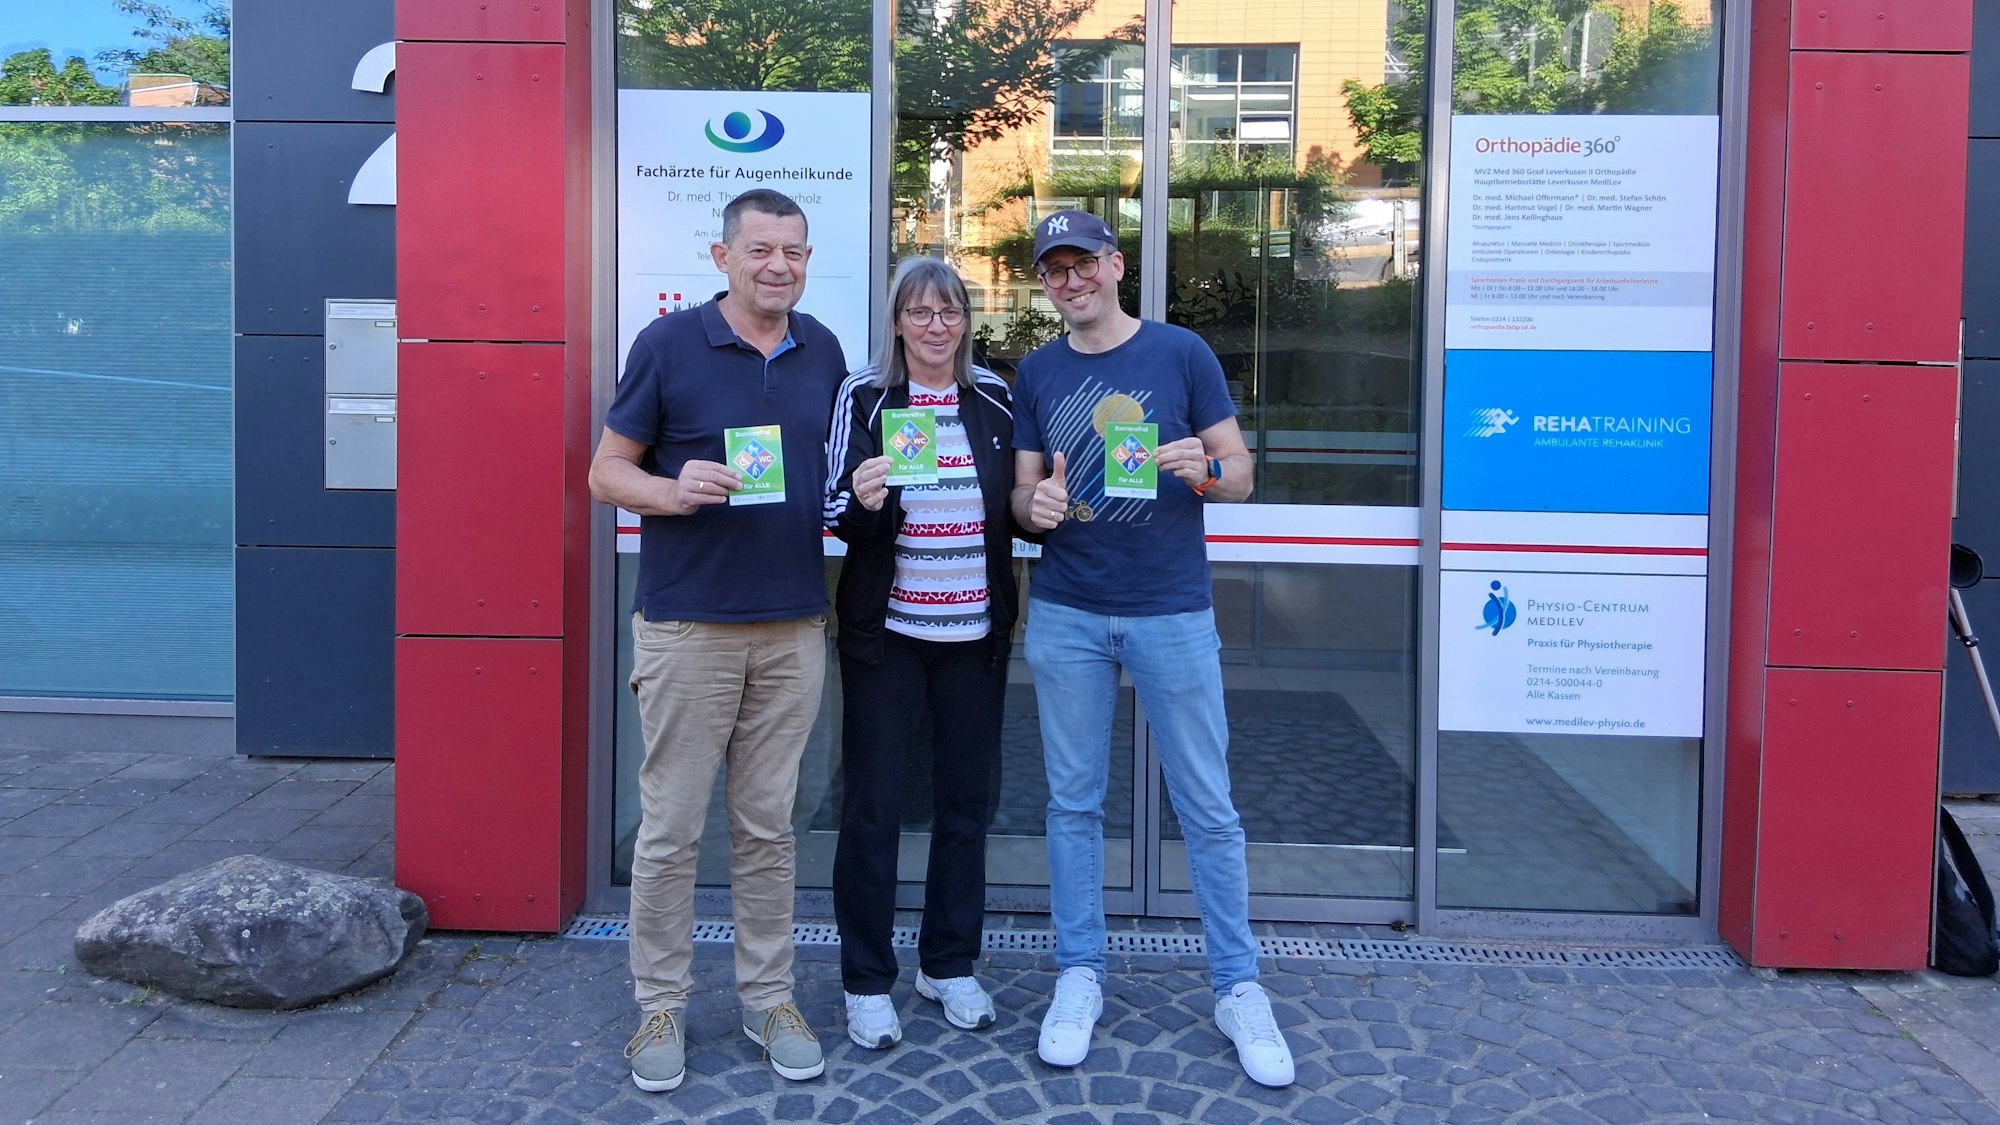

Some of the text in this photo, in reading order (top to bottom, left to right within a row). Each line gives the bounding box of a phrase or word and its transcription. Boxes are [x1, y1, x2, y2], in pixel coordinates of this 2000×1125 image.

[1475, 136, 1581, 157] Orthopädie
[636, 165, 853, 182] Fachärzte für Augenheilkunde
[668, 191, 682, 202] Dr.
[687, 192, 714, 202] med.
[719, 192, 737, 203] Tho
[1537, 204, 1557, 212] Vogel
[1521, 214, 1563, 222] Kellinghaus
[694, 230, 708, 238] Am
[697, 252, 712, 261] Tele
[1533, 415, 1691, 434] REHATRAINING
[913, 437, 927, 445] WC
[1533, 438, 1664, 449] AMBULANTE REHAKLINIK
[759, 455, 772, 463] WC
[1527, 599, 1650, 613] PHYSIO-CENTRUM
[1527, 616, 1585, 627] MEDILEV
[1527, 638, 1653, 652] Praxis für Physiotherapie
[1527, 664, 1659, 679] Termine nach Vereinbarung
[1526, 678, 1603, 688] 0214-500044-0
[1526, 690, 1581, 701] Alle Kassen
[1526, 717, 1646, 729] www.medilev-physio.de
